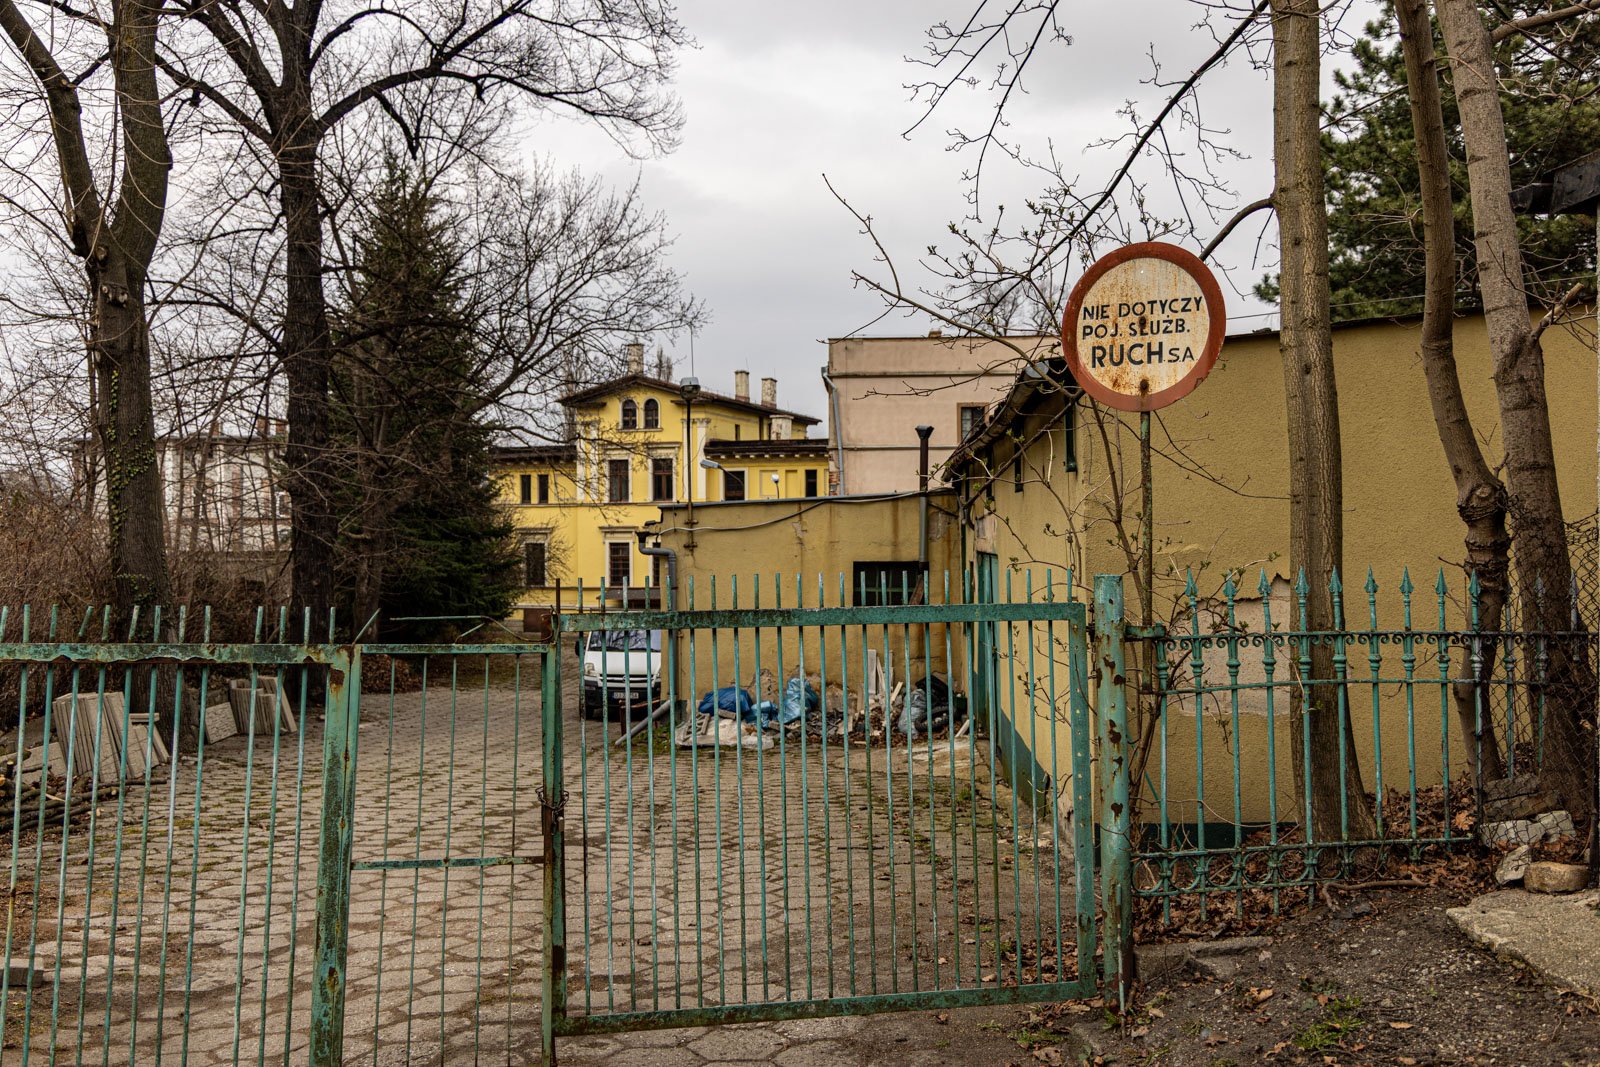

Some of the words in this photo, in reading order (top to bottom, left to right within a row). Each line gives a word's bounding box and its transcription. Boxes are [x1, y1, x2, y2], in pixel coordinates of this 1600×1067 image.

[1082, 305, 1110, 321] NIE
[1118, 296, 1203, 318] DOTYCZY
[1082, 323, 1123, 340] POJ.
[1091, 341, 1164, 369] RUCH
